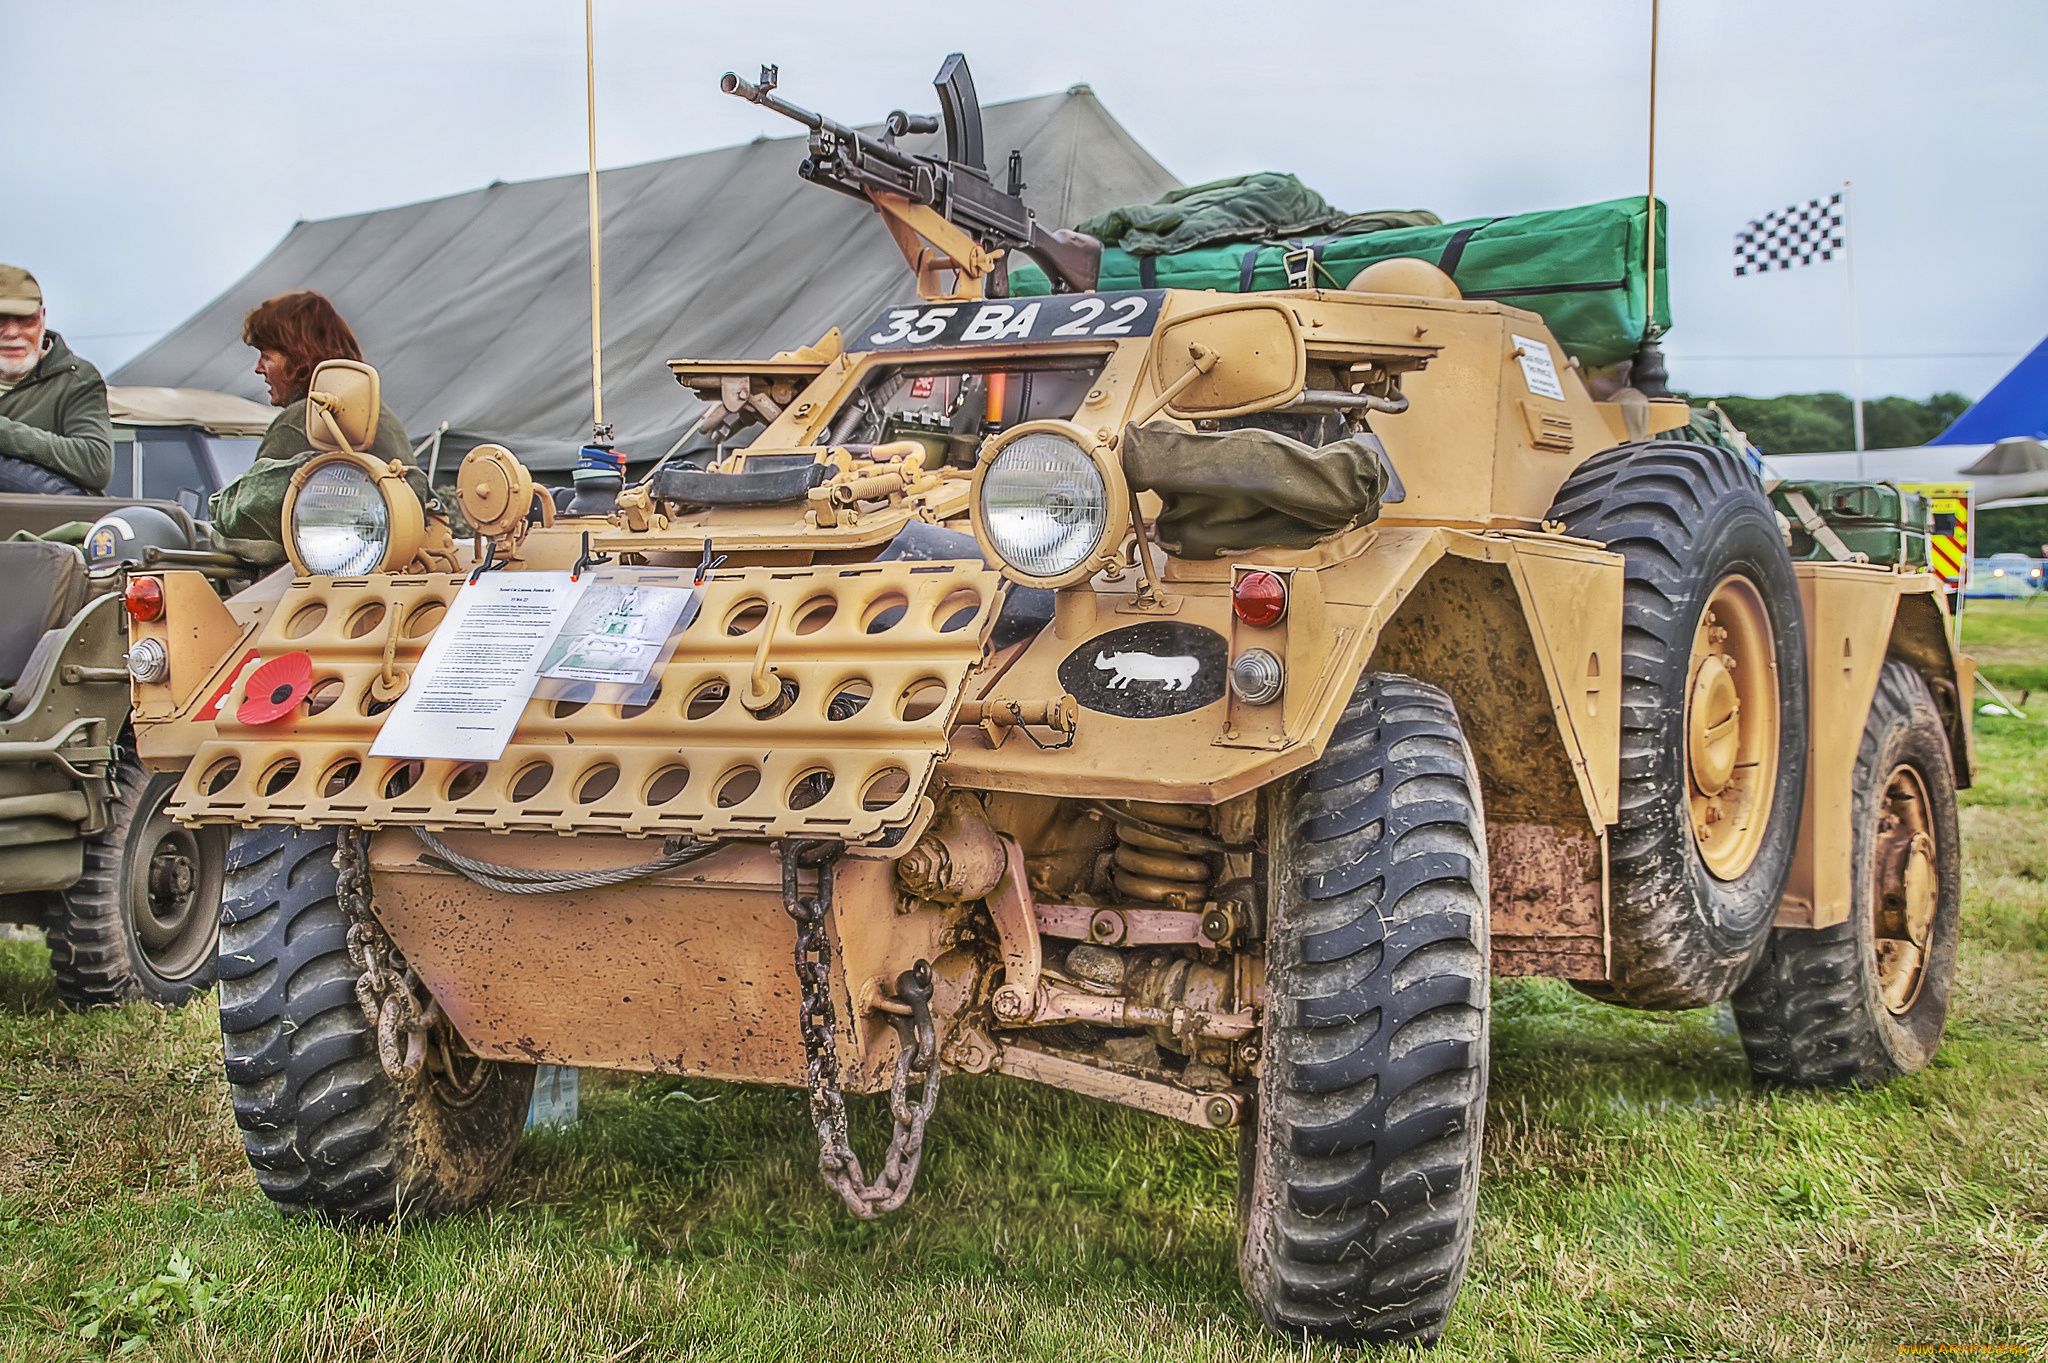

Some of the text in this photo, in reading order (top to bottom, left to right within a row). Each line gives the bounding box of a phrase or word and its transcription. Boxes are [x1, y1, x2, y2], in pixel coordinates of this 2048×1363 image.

[869, 296, 1148, 345] 35 BA 22
